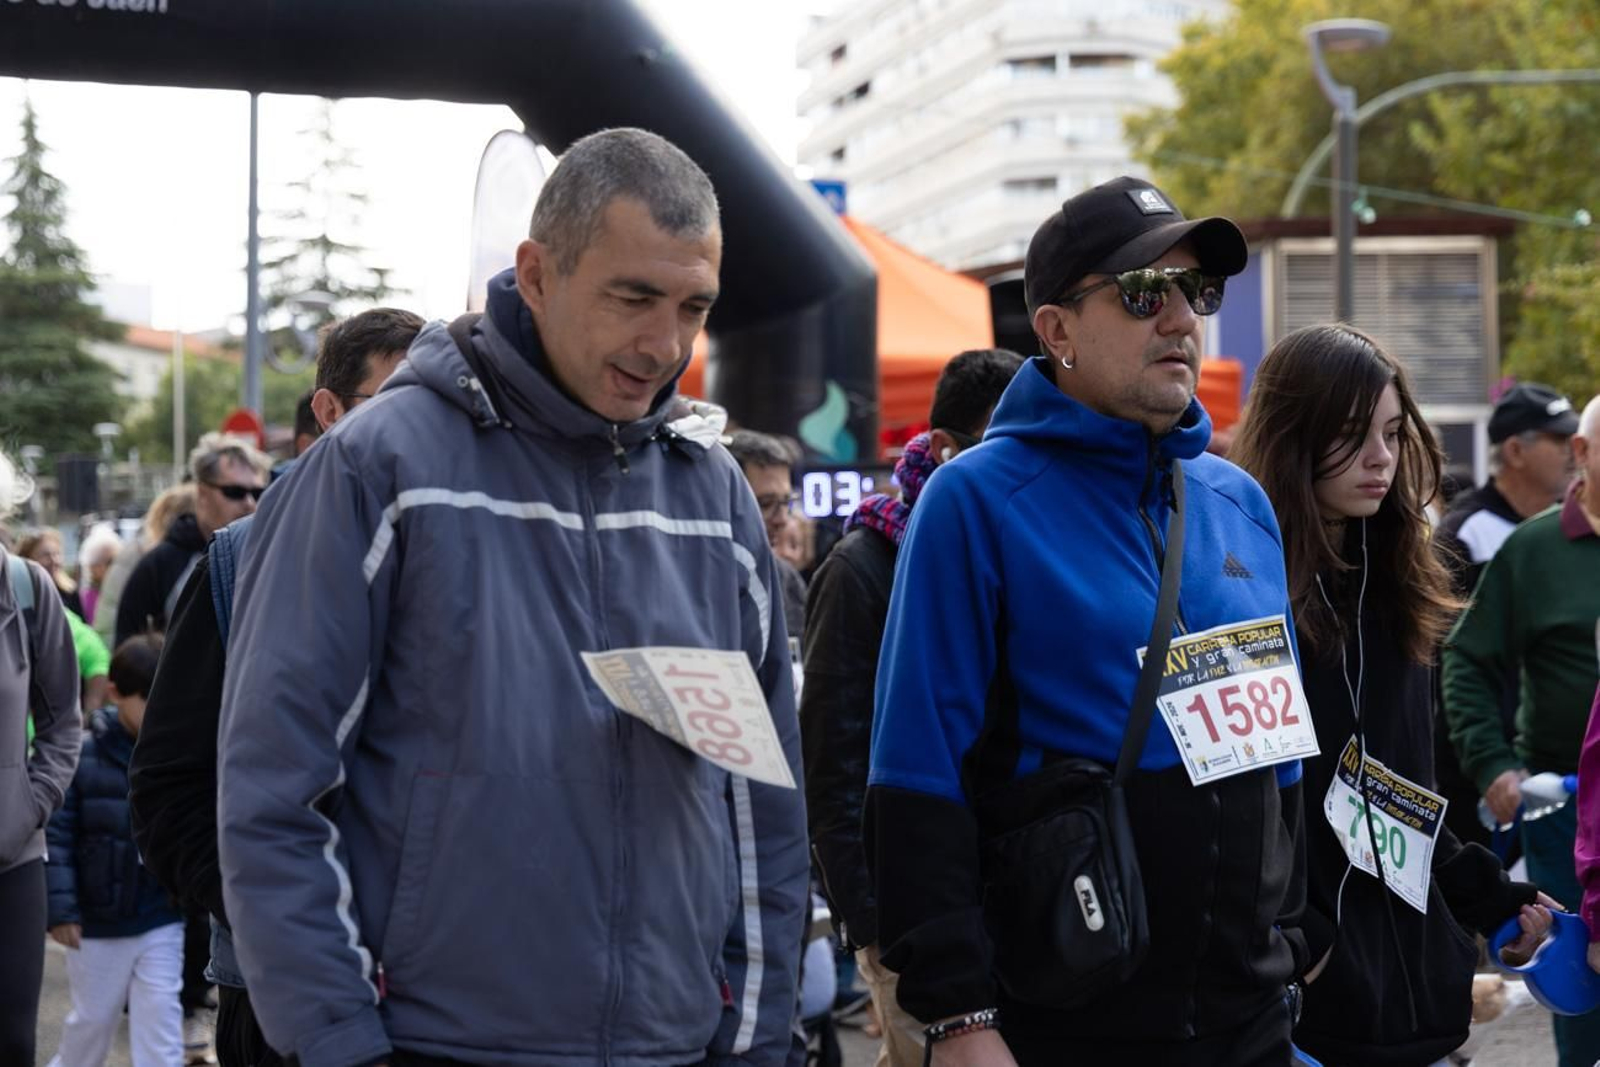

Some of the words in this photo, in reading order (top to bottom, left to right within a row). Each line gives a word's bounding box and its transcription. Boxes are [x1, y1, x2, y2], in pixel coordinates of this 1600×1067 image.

[1239, 626, 1282, 644] POPULAR
[1162, 647, 1189, 677] XV
[1191, 656, 1200, 668] y
[1206, 648, 1235, 665] gran
[1239, 637, 1285, 655] caminata
[1186, 676, 1300, 743] 1582
[1366, 776, 1389, 795] gran
[1391, 792, 1436, 821] caminata
[1395, 785, 1439, 812] POPULAR
[1347, 795, 1406, 870] 790
[1080, 888, 1097, 917] FILA
